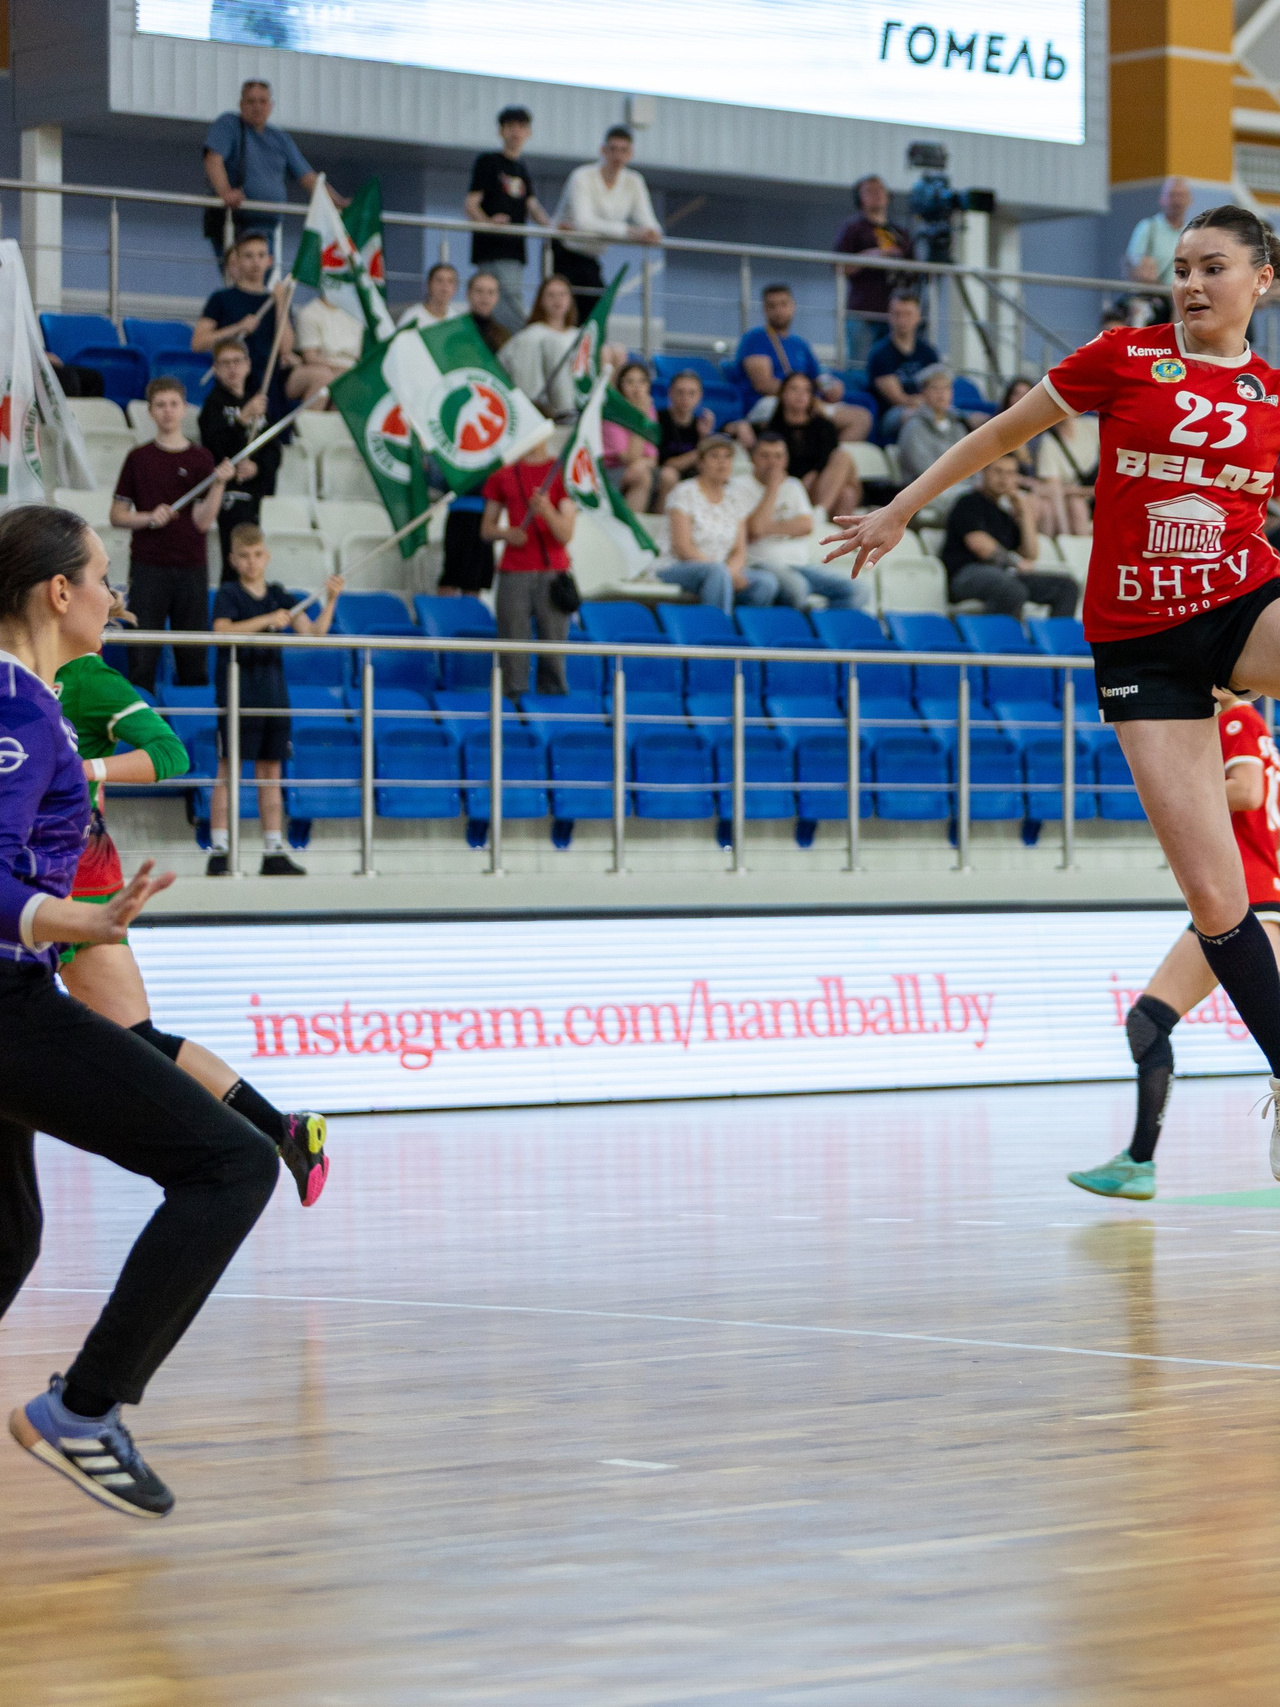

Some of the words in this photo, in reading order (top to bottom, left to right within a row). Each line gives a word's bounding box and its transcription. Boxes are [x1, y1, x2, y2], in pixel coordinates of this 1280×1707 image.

[880, 21, 1066, 81] ГОМЕЛЬ
[1127, 345, 1172, 357] Kempa
[1169, 390, 1248, 449] 23
[1116, 448, 1274, 495] BELAZ
[1117, 549, 1250, 601] БНТУ
[1167, 599, 1212, 617] 1920
[1195, 928, 1240, 946] mpa
[247, 973, 995, 1070] instagram.com/handball.by
